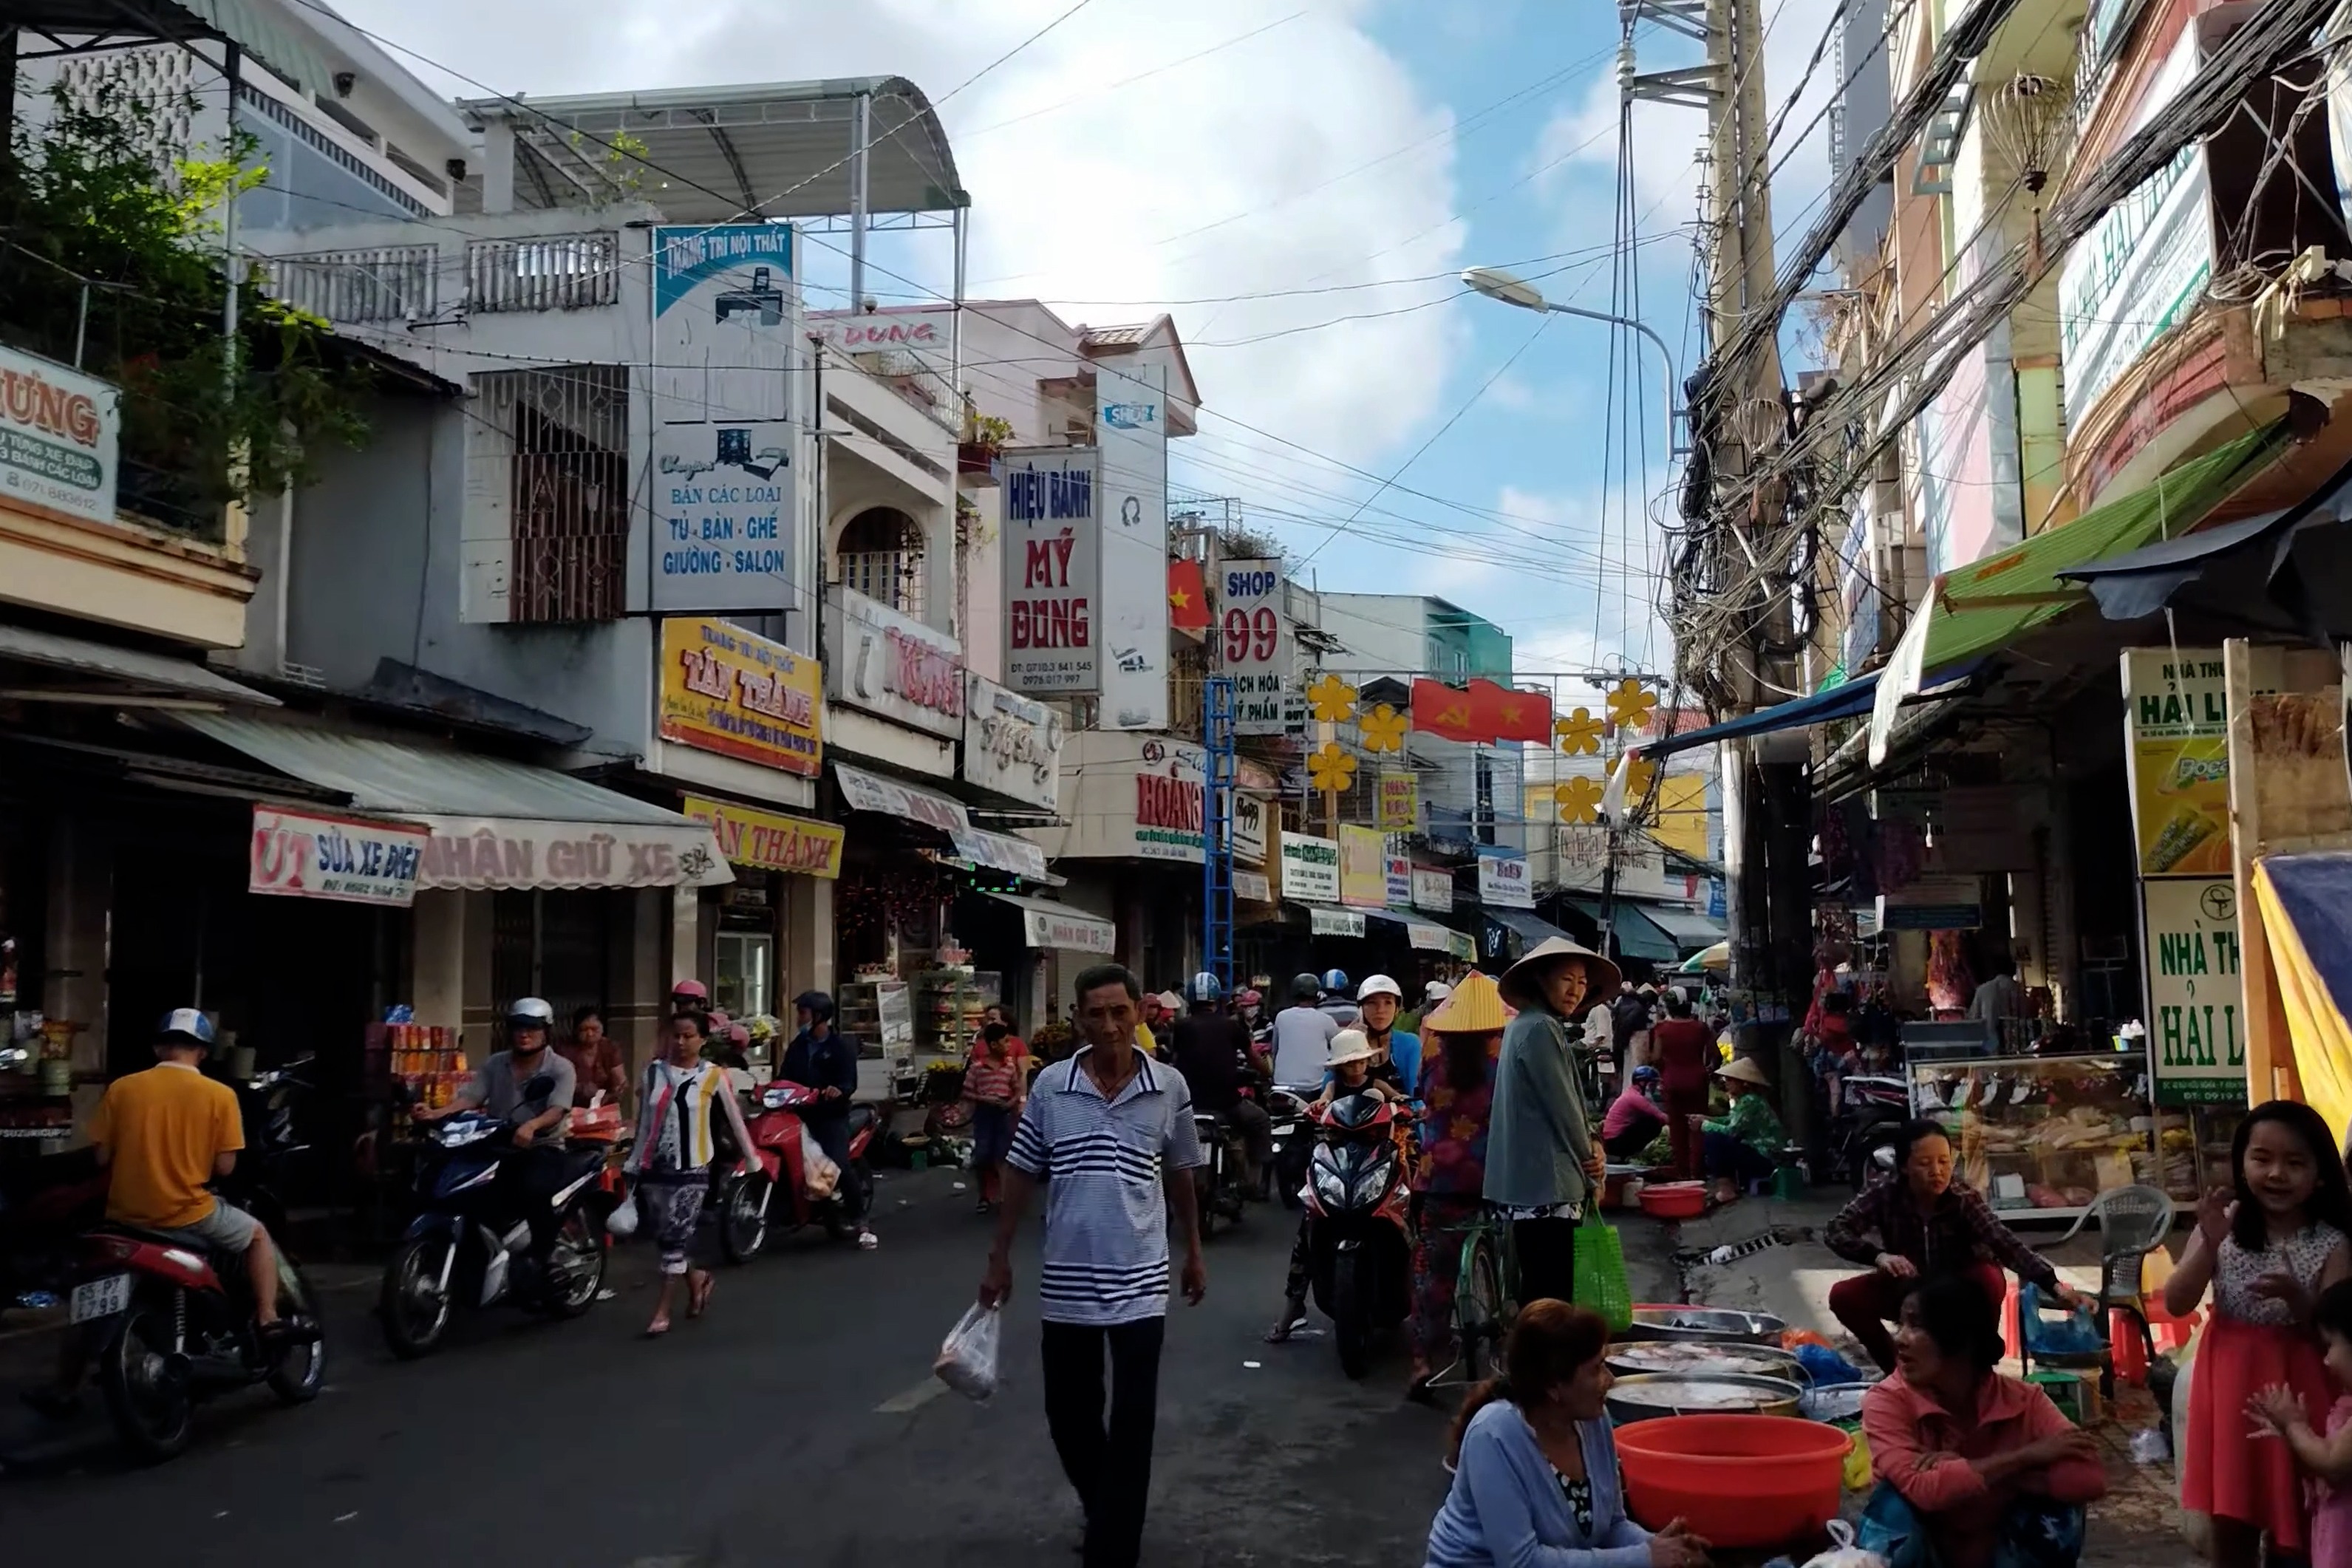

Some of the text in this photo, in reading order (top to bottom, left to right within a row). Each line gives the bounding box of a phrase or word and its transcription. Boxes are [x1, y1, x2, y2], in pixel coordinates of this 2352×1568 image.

[730, 231, 751, 259] NỘI
[10, 434, 42, 455] TÙNG
[44, 446, 63, 461] XE
[12, 451, 46, 471] BÁNH
[672, 484, 702, 504] BÁN
[709, 484, 740, 503] CÁC
[1010, 460, 1091, 528] HIỆU BÁNH
[669, 507, 778, 540] TỦ BÀN GHẾ
[664, 545, 785, 574] GIƯỜNG SALON
[1026, 527, 1076, 588] MỸ
[1227, 571, 1276, 596] SHOP
[1224, 607, 1278, 662] 99
[1230, 670, 1280, 693] ÁCH HÓA
[1248, 696, 1278, 720] PHẨM
[2140, 683, 2193, 724] HẢI
[359, 840, 382, 876] XE
[546, 834, 615, 879] GIỮ
[627, 842, 675, 879] XE
[2160, 919, 2208, 975] NHÀ
[2161, 979, 2217, 1066] HẢI
